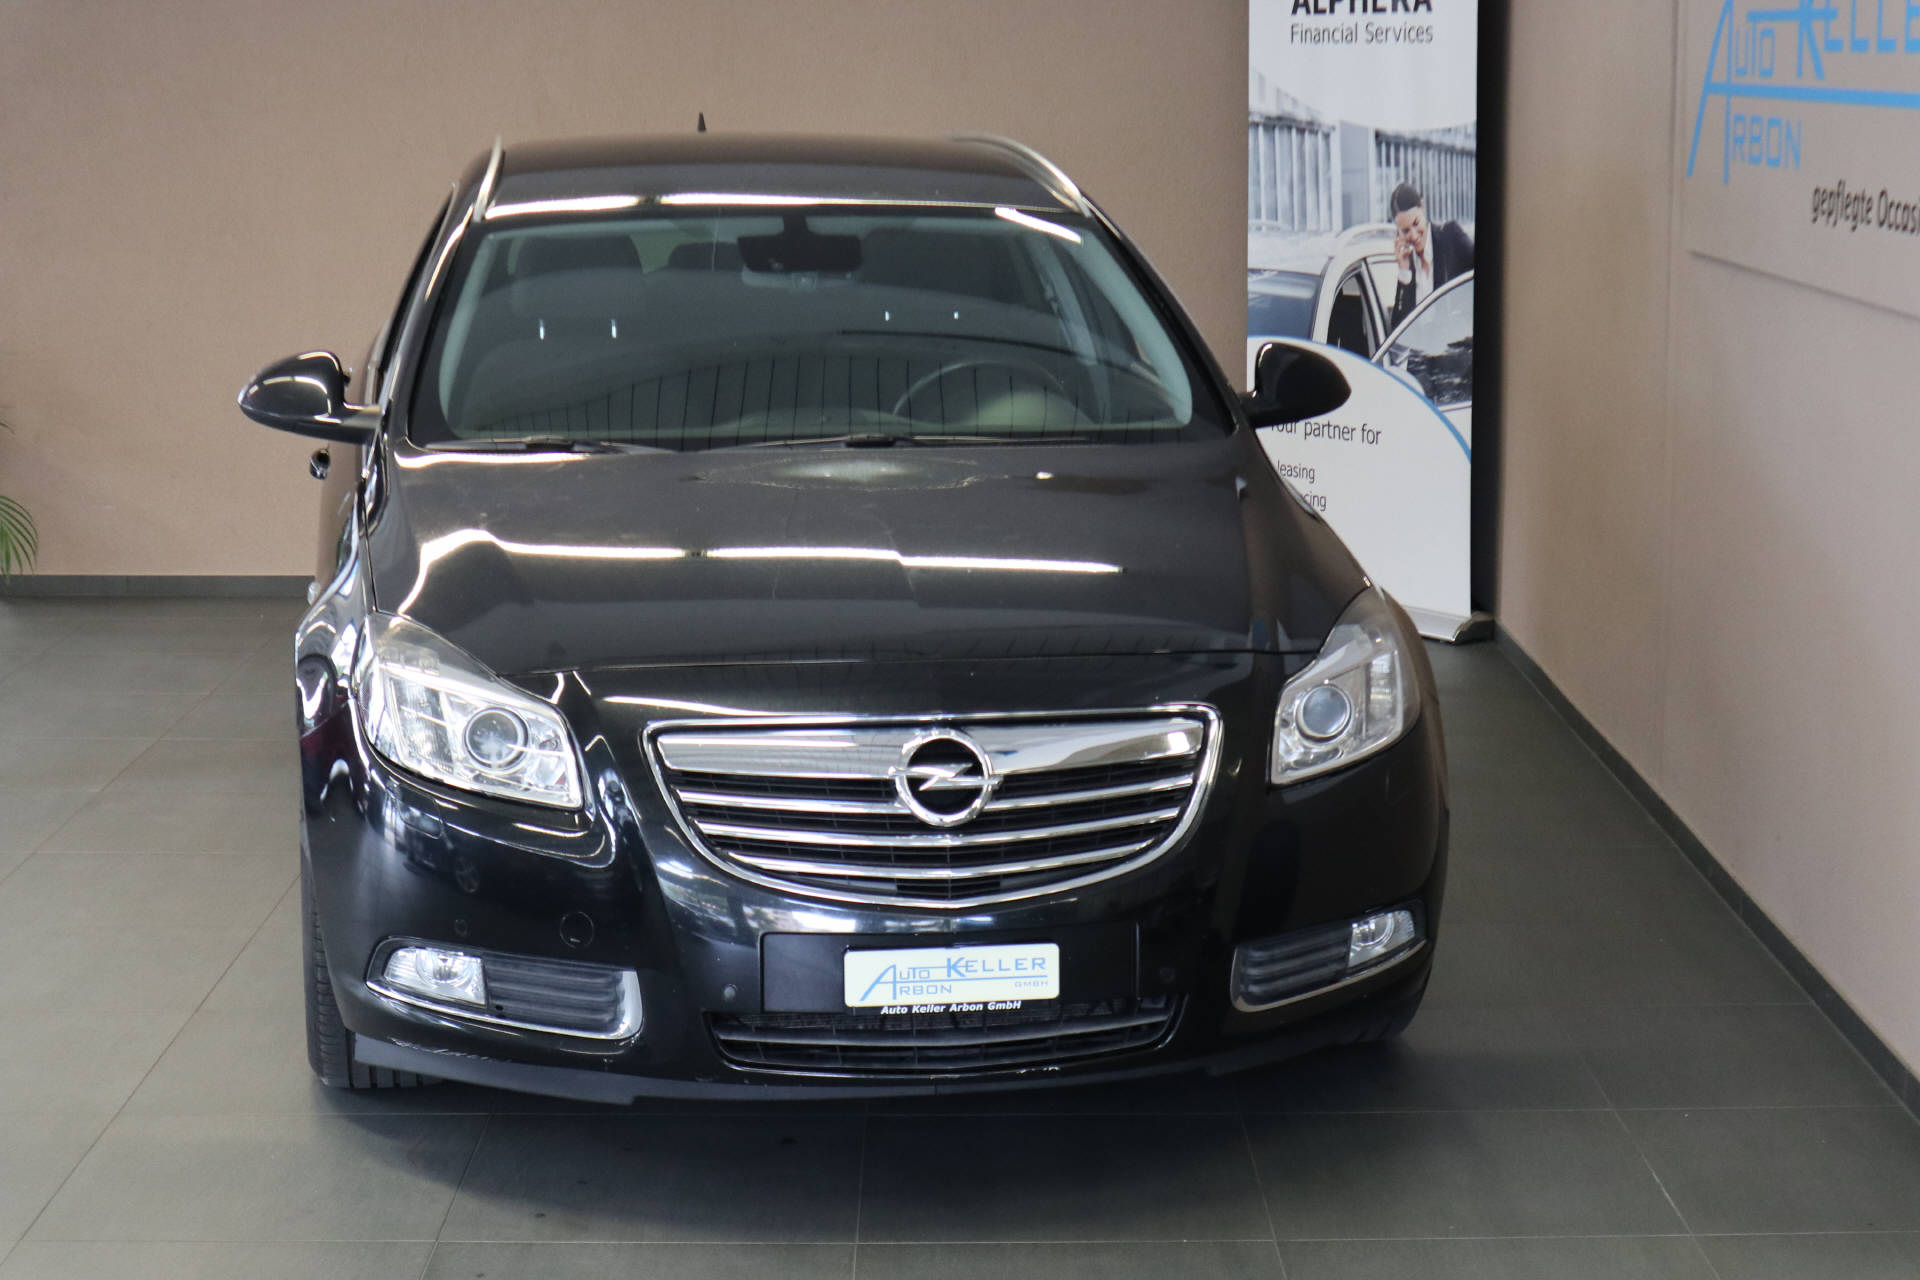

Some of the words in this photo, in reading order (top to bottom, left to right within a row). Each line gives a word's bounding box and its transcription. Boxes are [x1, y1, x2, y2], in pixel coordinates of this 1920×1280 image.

[1290, 22, 1358, 44] Financial
[1365, 21, 1434, 44] Services
[1812, 178, 1873, 233] gepflegte
[1304, 420, 1356, 441] partner
[1361, 423, 1382, 445] for
[1277, 460, 1316, 484] leasing
[946, 957, 1046, 978] KELLER
[880, 1005, 910, 1015] Auto
[911, 1004, 946, 1014] Keller
[949, 1002, 984, 1012] Arbon
[987, 1000, 1022, 1011] GmbH
